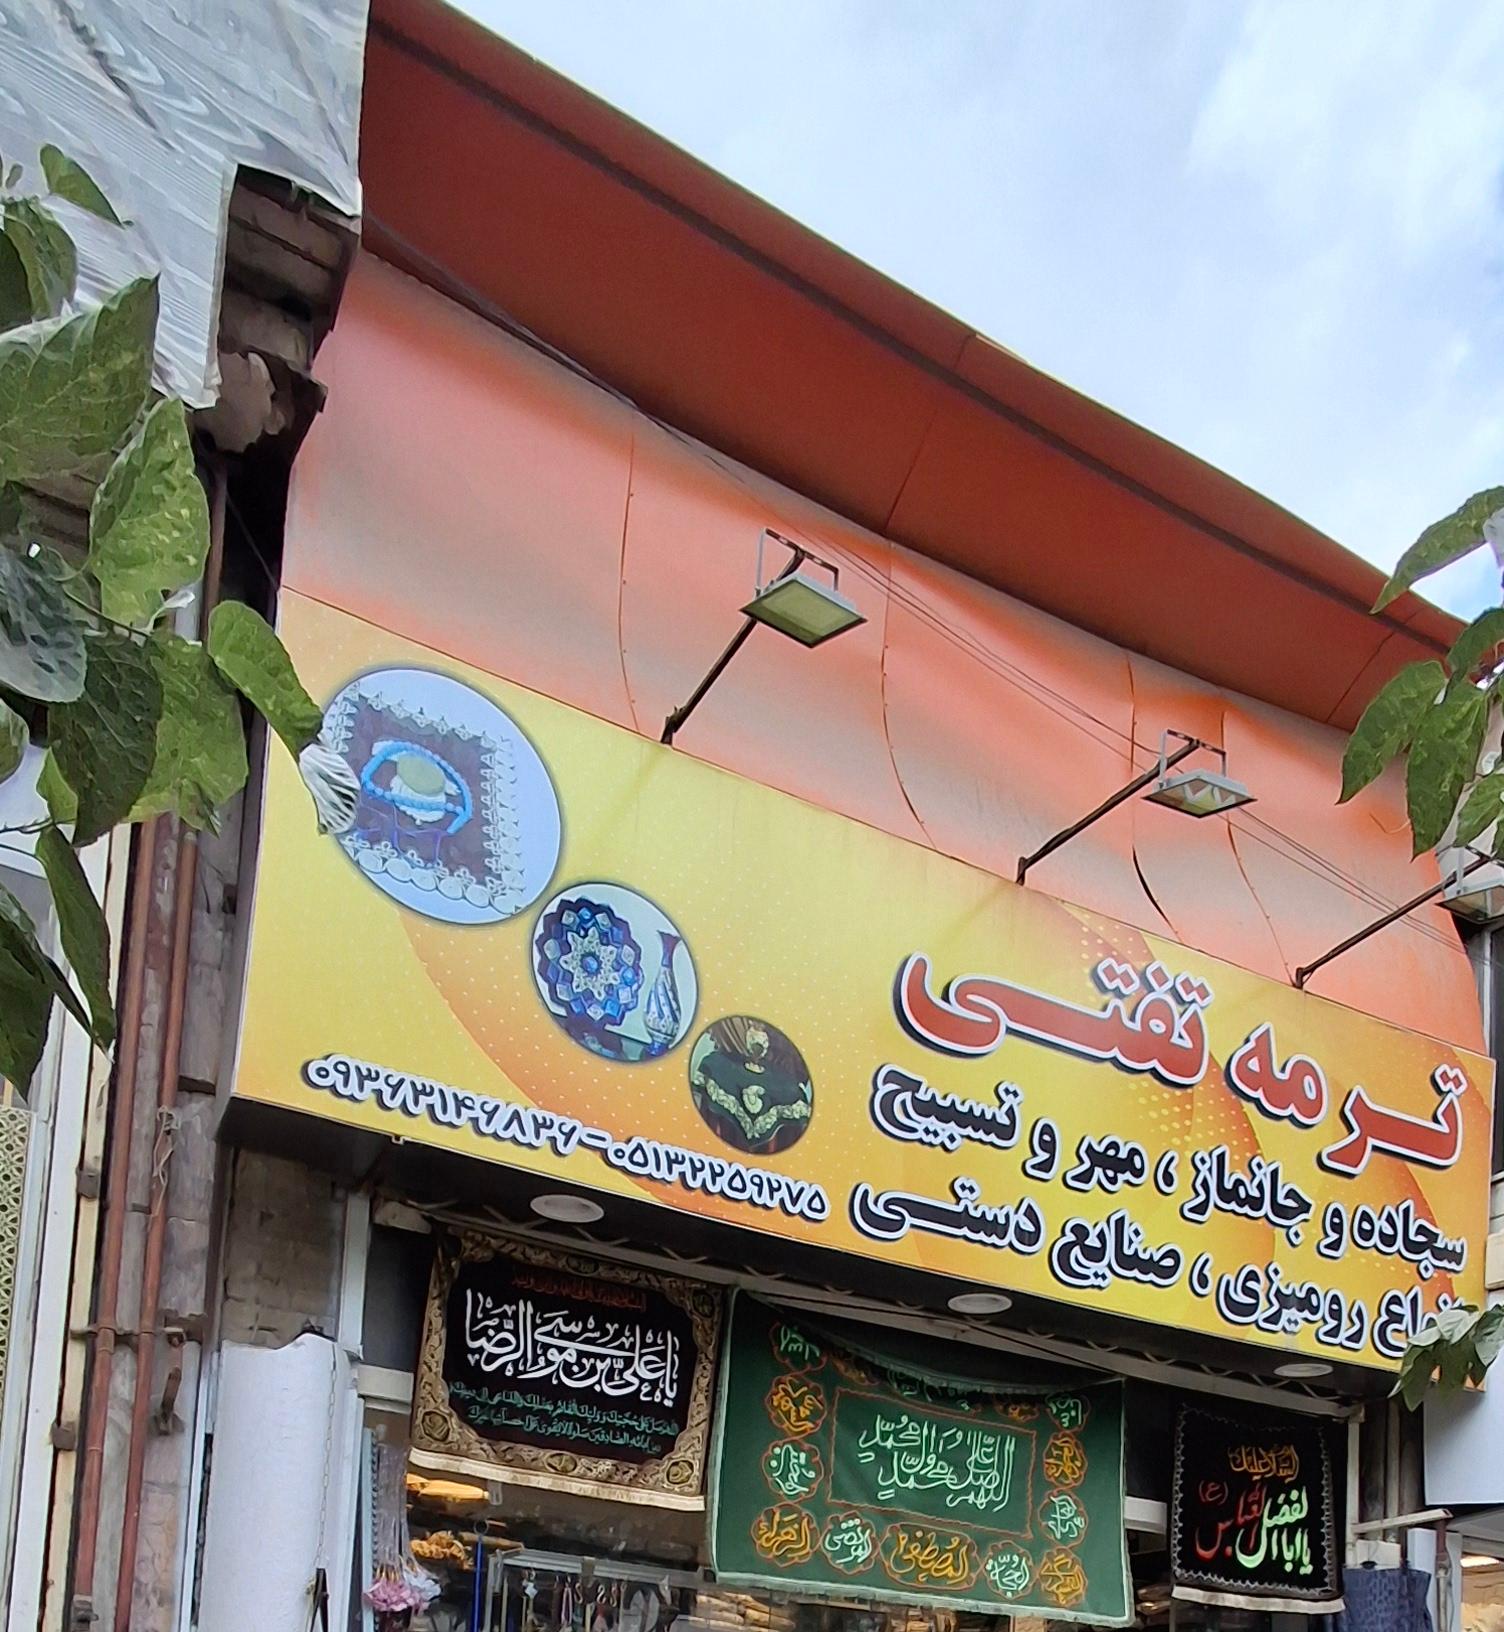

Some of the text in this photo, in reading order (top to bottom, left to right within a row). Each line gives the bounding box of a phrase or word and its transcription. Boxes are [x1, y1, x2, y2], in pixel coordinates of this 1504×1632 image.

[894, 951, 1214, 1088] تفتی
[871, 1063, 1024, 1152] تسبیح
[1026, 1117, 1060, 1183] و
[1065, 1135, 1146, 1193] مهر
[851, 1178, 1045, 1254] دستی
[1183, 1148, 1314, 1246] جانماز
[1318, 1202, 1348, 1260] و
[1052, 1210, 1184, 1291] صنایع
[1352, 1200, 1468, 1276] سجاده
[1215, 1262, 1368, 1350] رومیزی
